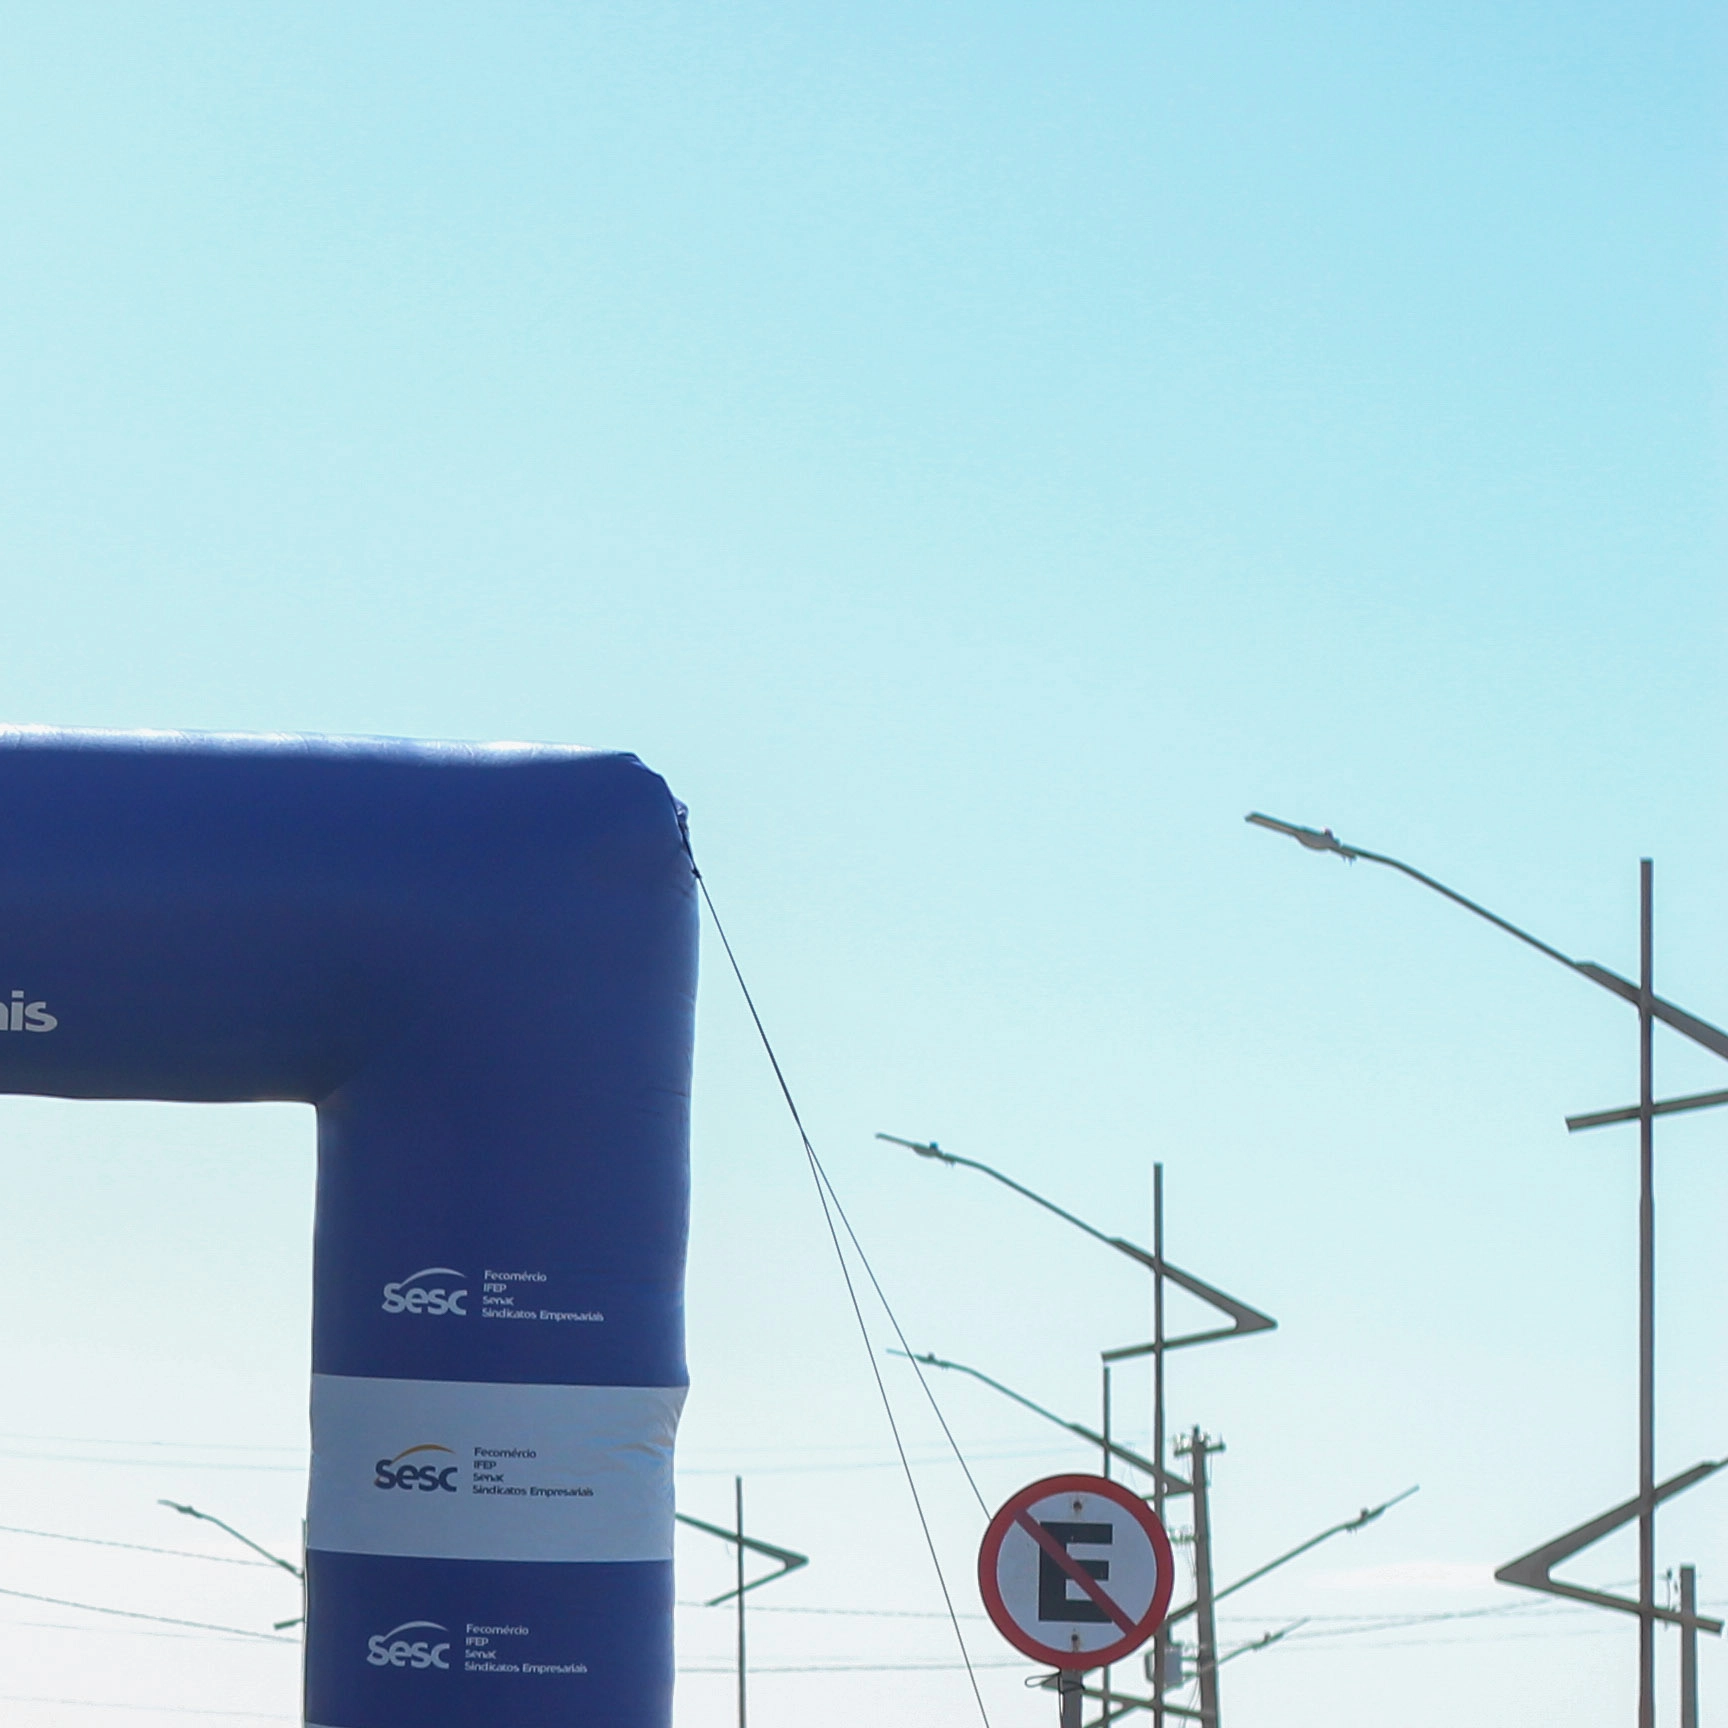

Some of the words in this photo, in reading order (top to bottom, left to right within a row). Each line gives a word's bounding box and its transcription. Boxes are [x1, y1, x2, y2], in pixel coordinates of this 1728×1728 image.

[484, 1269, 548, 1283] Fecomércio
[483, 1282, 507, 1294] IFEP
[382, 1282, 468, 1316] Sesc
[481, 1306, 538, 1320] Sindicatos
[539, 1310, 605, 1323] Empresariais
[473, 1446, 537, 1460] Fecomércio
[473, 1459, 497, 1471] IFEP
[374, 1459, 458, 1493] Sesc
[472, 1484, 528, 1497] Sindicatos
[530, 1486, 594, 1499] Empresariais
[1038, 1521, 1114, 1623] E
[466, 1622, 530, 1636] Fecomércio
[465, 1635, 490, 1647] IFEP
[366, 1635, 451, 1670] Sesc
[464, 1660, 520, 1674] Sindicatos
[521, 1662, 589, 1675] Empresariais
